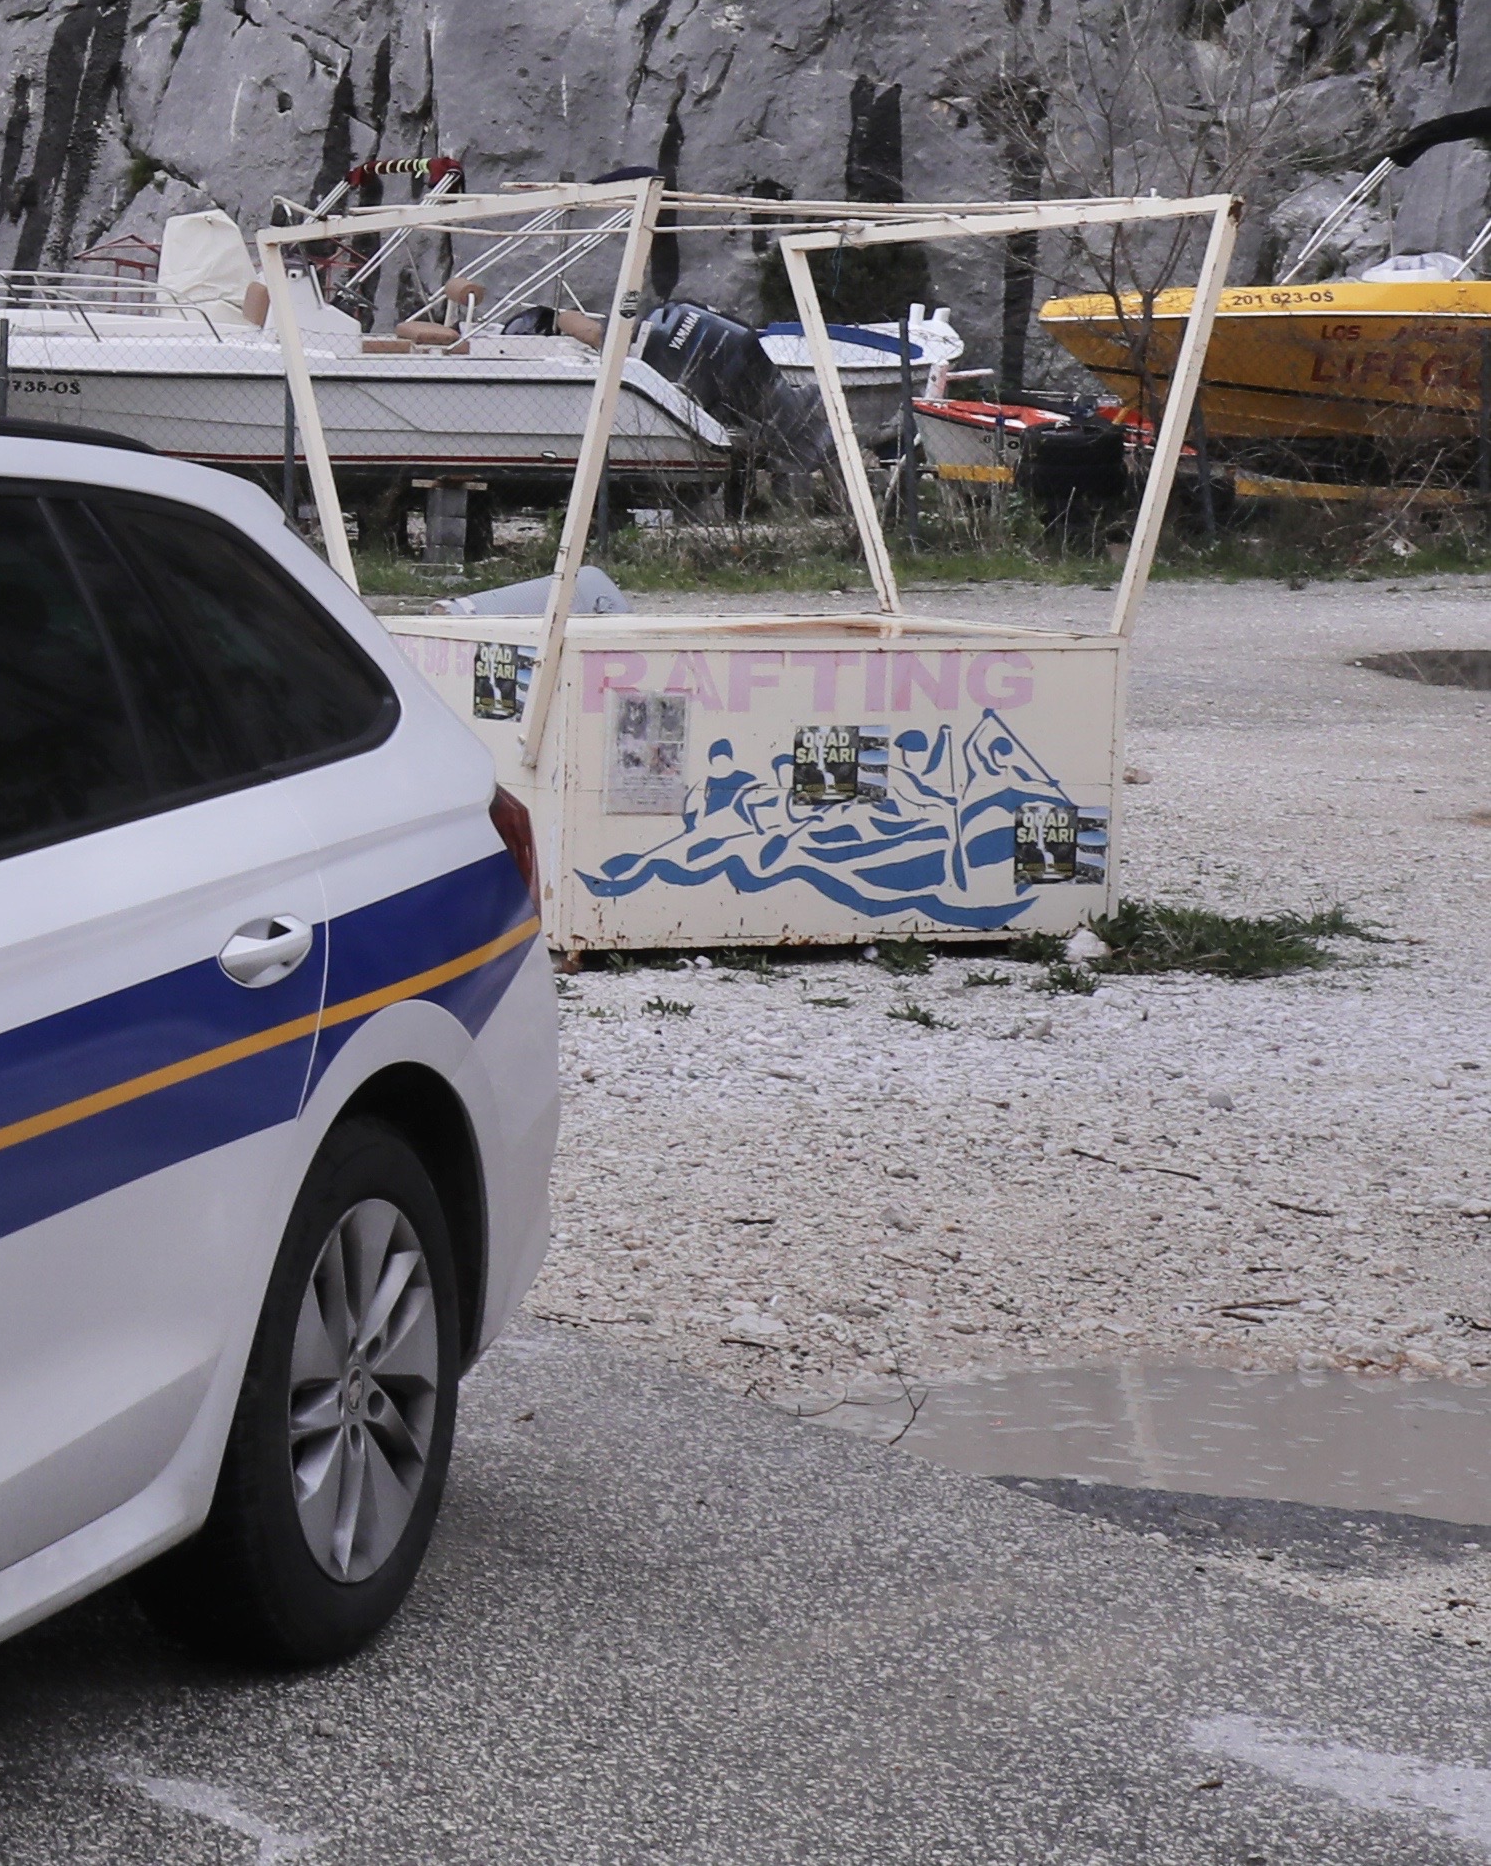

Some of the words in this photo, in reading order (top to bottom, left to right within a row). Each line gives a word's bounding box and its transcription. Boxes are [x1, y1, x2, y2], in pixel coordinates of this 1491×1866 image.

[1232, 294, 1263, 305] 201
[669, 311, 701, 350] YAMAHA
[1320, 325, 1362, 341] LOS
[476, 661, 516, 679] SAFARI
[581, 650, 1034, 713] RAFTING
[802, 732, 850, 749] QUAD
[795, 747, 856, 764] SAFARI
[1022, 812, 1069, 829] QUAD
[1016, 827, 1075, 843] SAFARI
